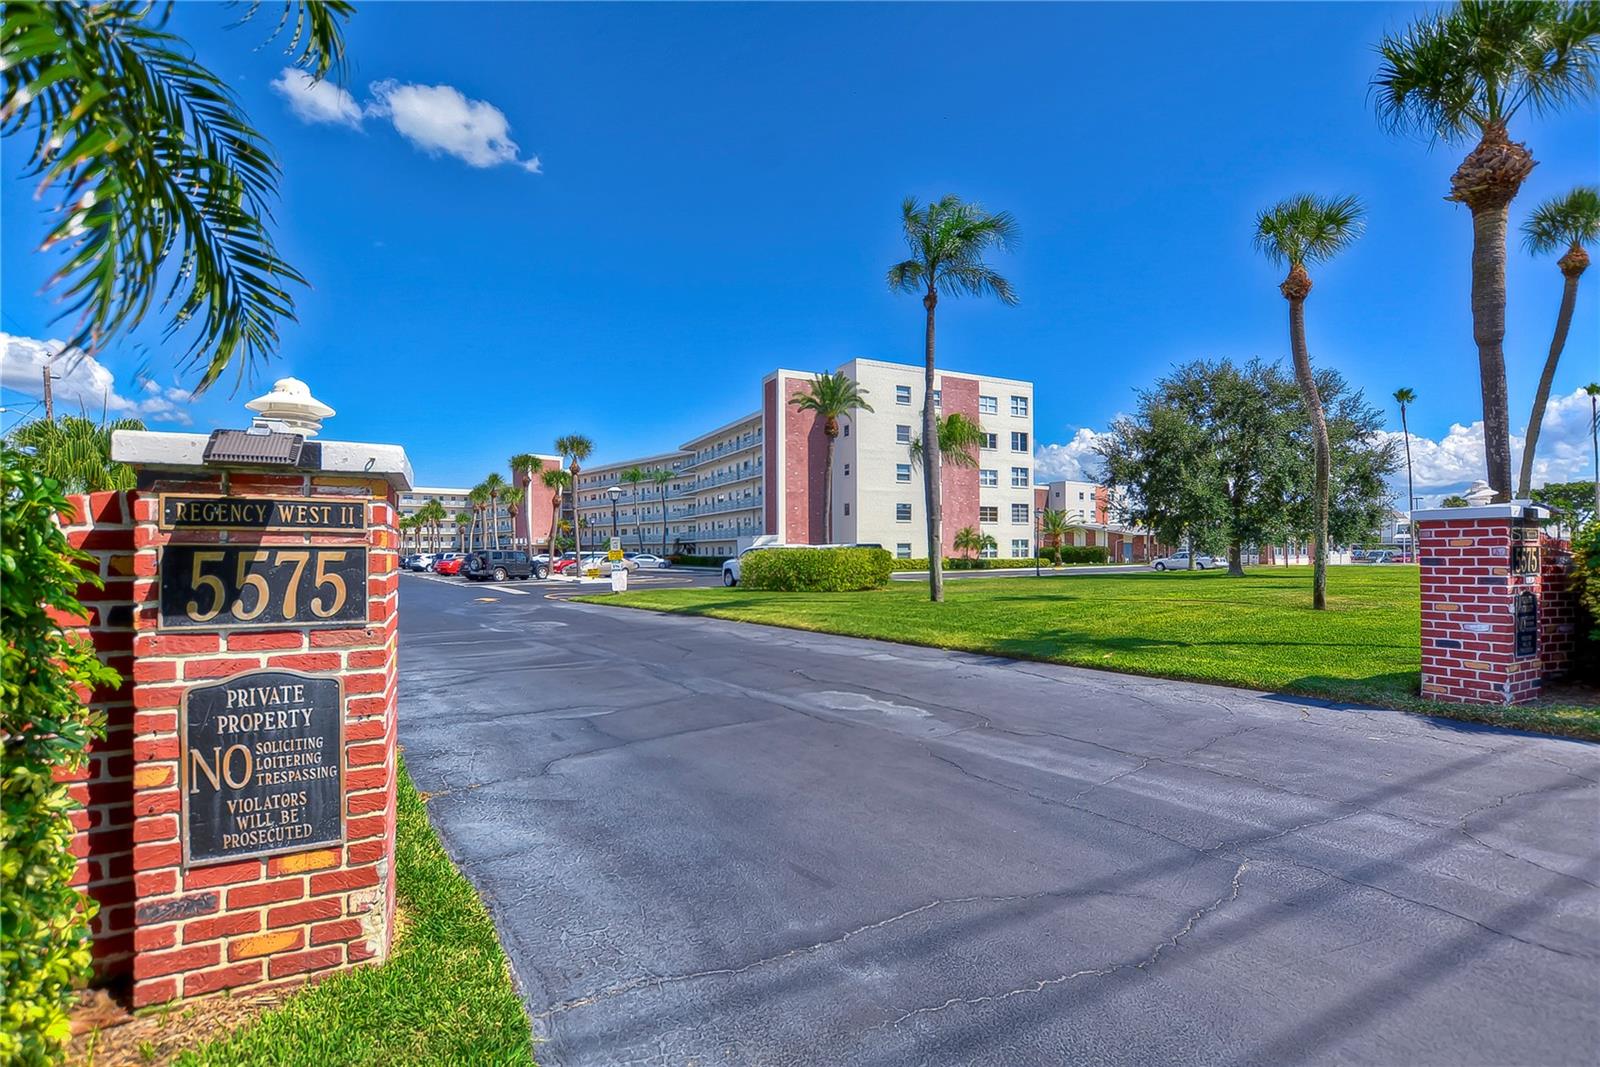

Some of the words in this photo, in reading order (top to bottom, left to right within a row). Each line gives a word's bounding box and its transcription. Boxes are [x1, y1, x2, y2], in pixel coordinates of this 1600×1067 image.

[175, 502, 266, 523] REGENCY
[277, 505, 331, 524] WEST
[341, 506, 354, 525] II
[1515, 547, 1538, 573] 5575
[186, 551, 347, 622] 5575
[226, 685, 305, 708] PRIVATE
[216, 708, 313, 735] PROPERTY
[255, 736, 324, 755] SOLICITING
[189, 743, 253, 794] NO
[255, 752, 322, 771] LOITERING
[255, 765, 337, 787] TRESPASSING
[226, 791, 307, 814] VIOLATORS
[235, 813, 273, 832] WILL
[281, 808, 299, 824] BE
[223, 823, 313, 849] PROSECUTED
